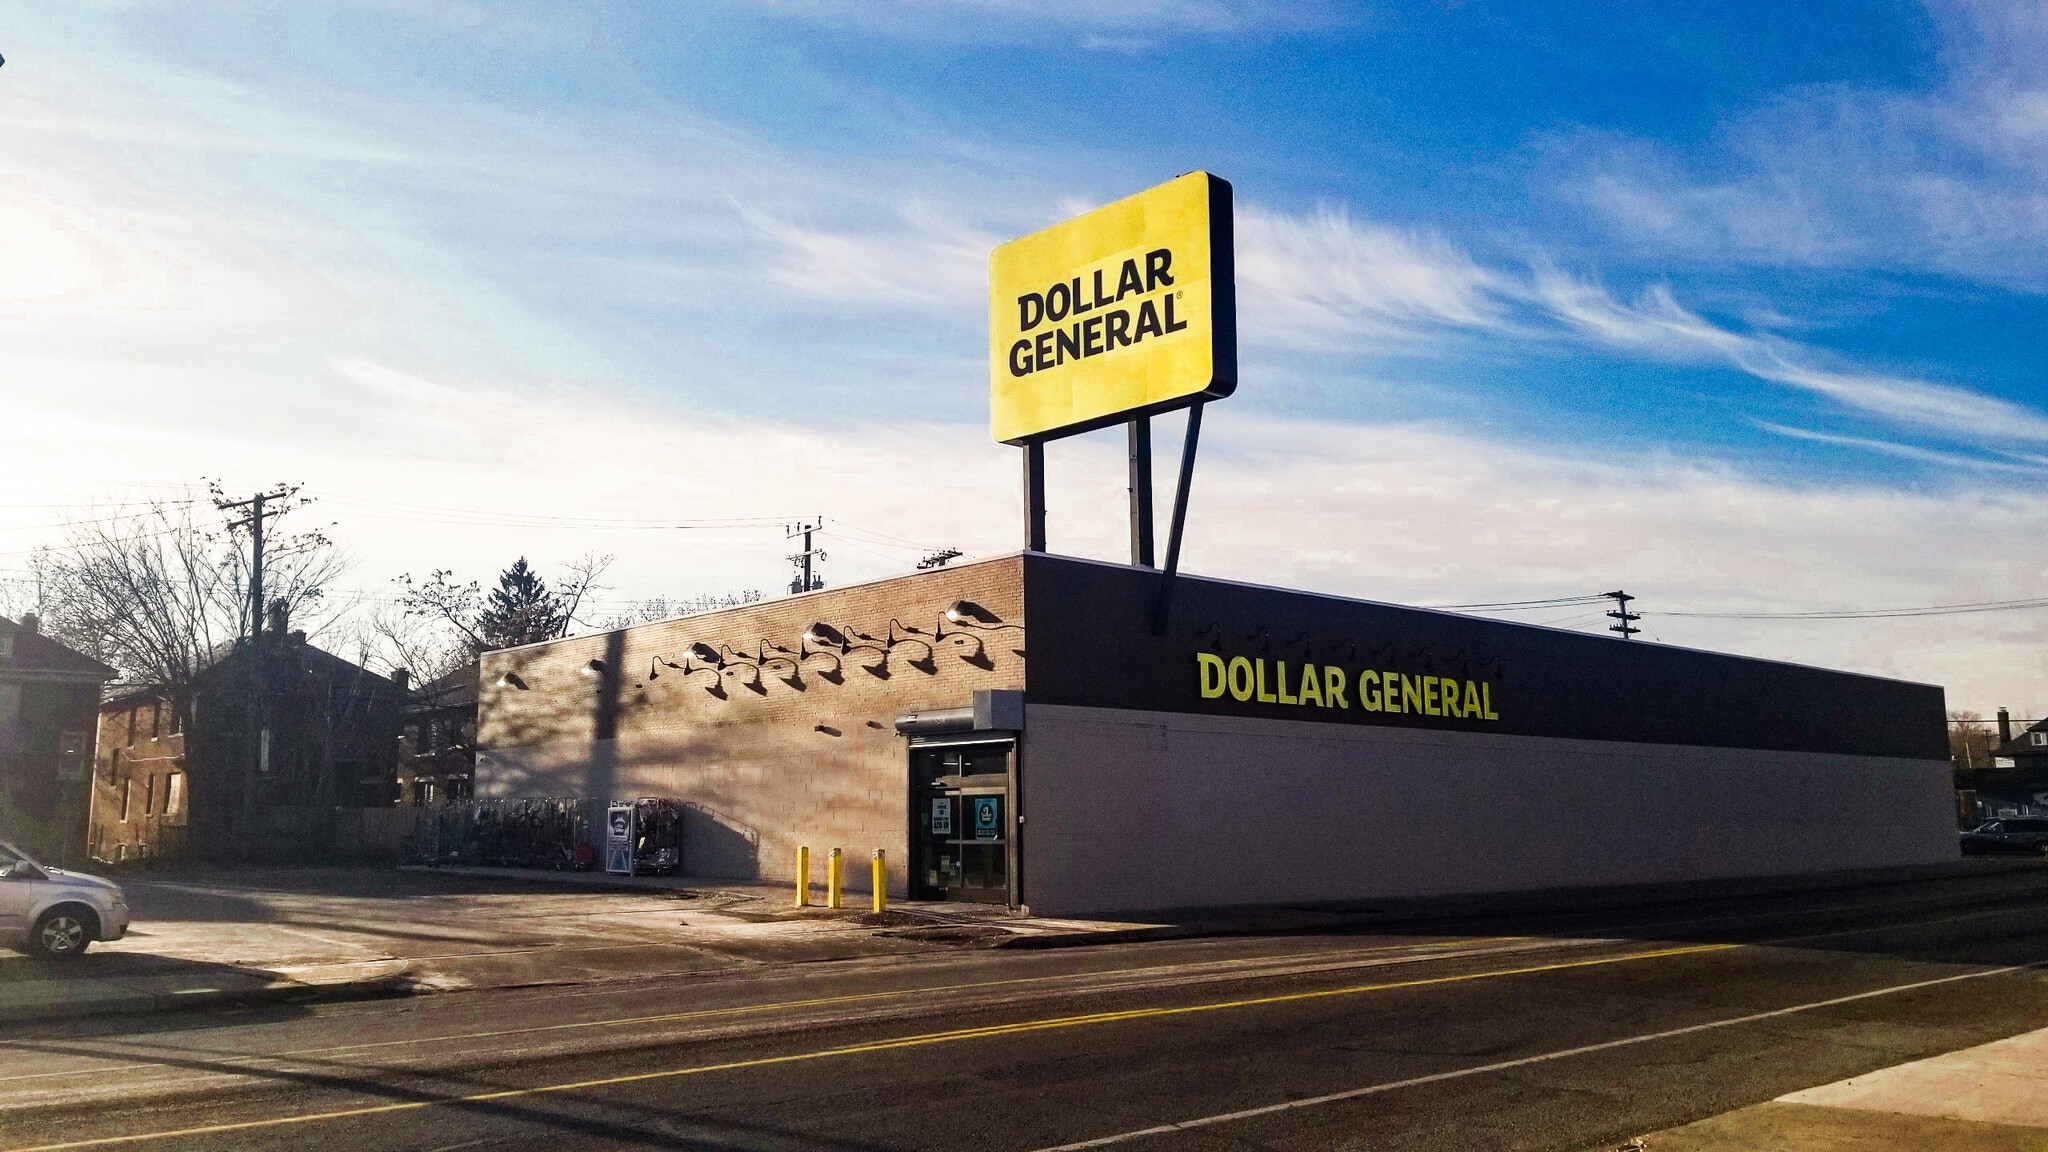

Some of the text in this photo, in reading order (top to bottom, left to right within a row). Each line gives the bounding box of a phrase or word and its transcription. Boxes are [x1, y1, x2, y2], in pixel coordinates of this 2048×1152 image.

[1017, 248, 1175, 332] DOLLAR
[1009, 293, 1187, 377] GENERAL
[1197, 652, 1499, 720] DOLLAR GENERAL
